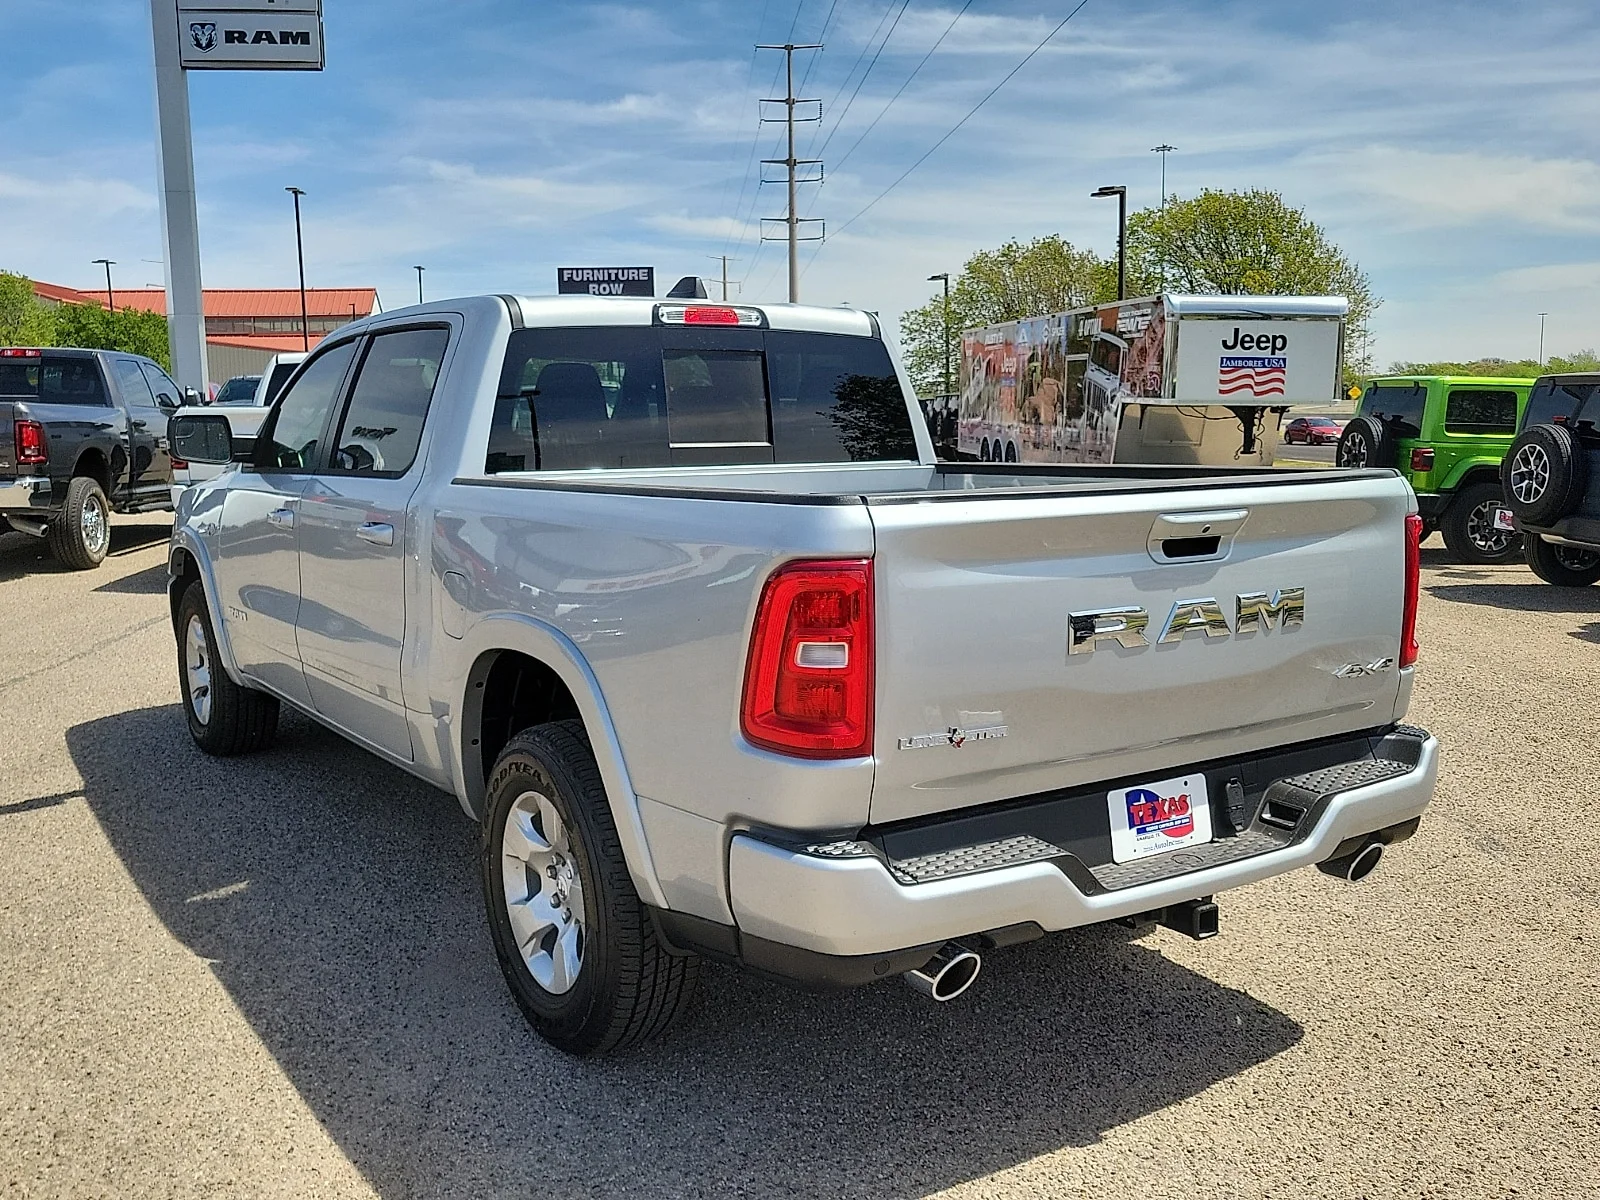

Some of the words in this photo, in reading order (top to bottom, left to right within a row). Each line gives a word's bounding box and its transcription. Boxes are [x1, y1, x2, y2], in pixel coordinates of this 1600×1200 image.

[224, 30, 311, 46] RAM
[562, 268, 649, 281] FURNITURE
[588, 283, 624, 295] ROW
[1221, 327, 1288, 356] Jeep
[1221, 358, 1264, 367] JAMBOREE
[1264, 358, 1285, 368] USA
[1067, 586, 1305, 656] RAM
[1130, 794, 1190, 826] TEXAS
